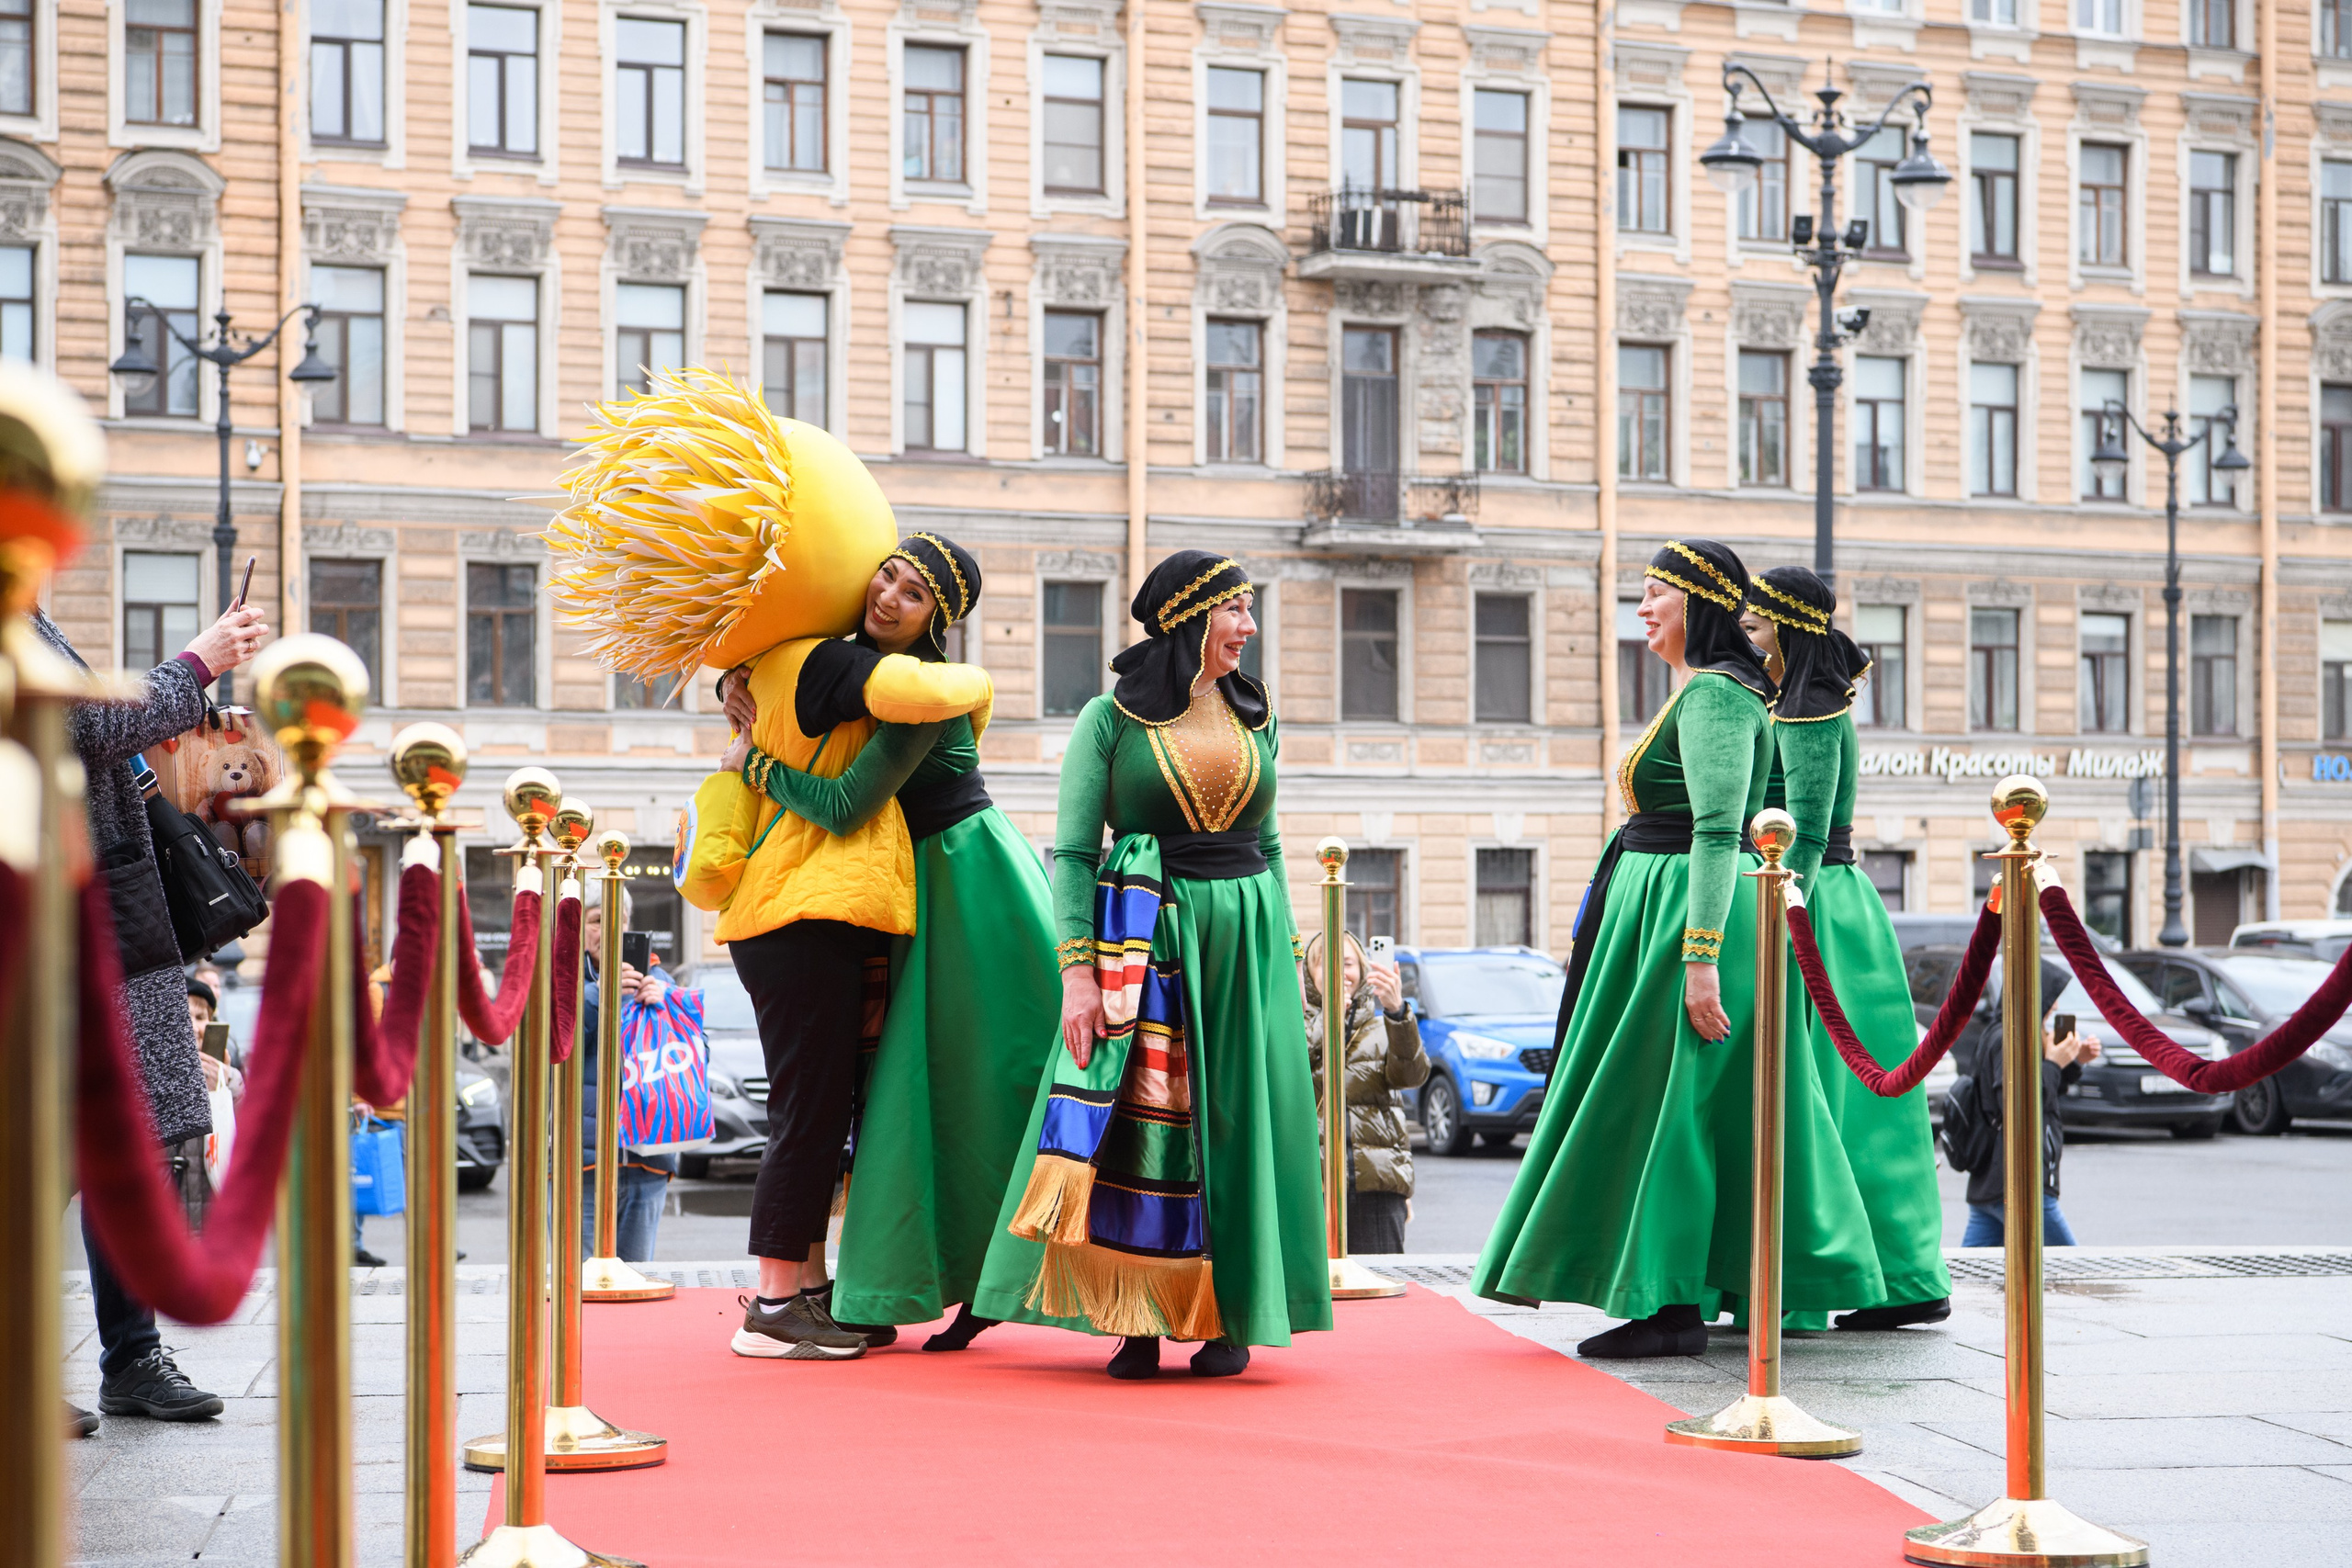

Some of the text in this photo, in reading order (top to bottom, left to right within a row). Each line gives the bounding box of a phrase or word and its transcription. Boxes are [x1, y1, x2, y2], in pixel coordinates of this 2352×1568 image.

[1859, 752, 1926, 776] алон
[1931, 746, 2056, 784] Красоты
[2312, 754, 2352, 782] НО
